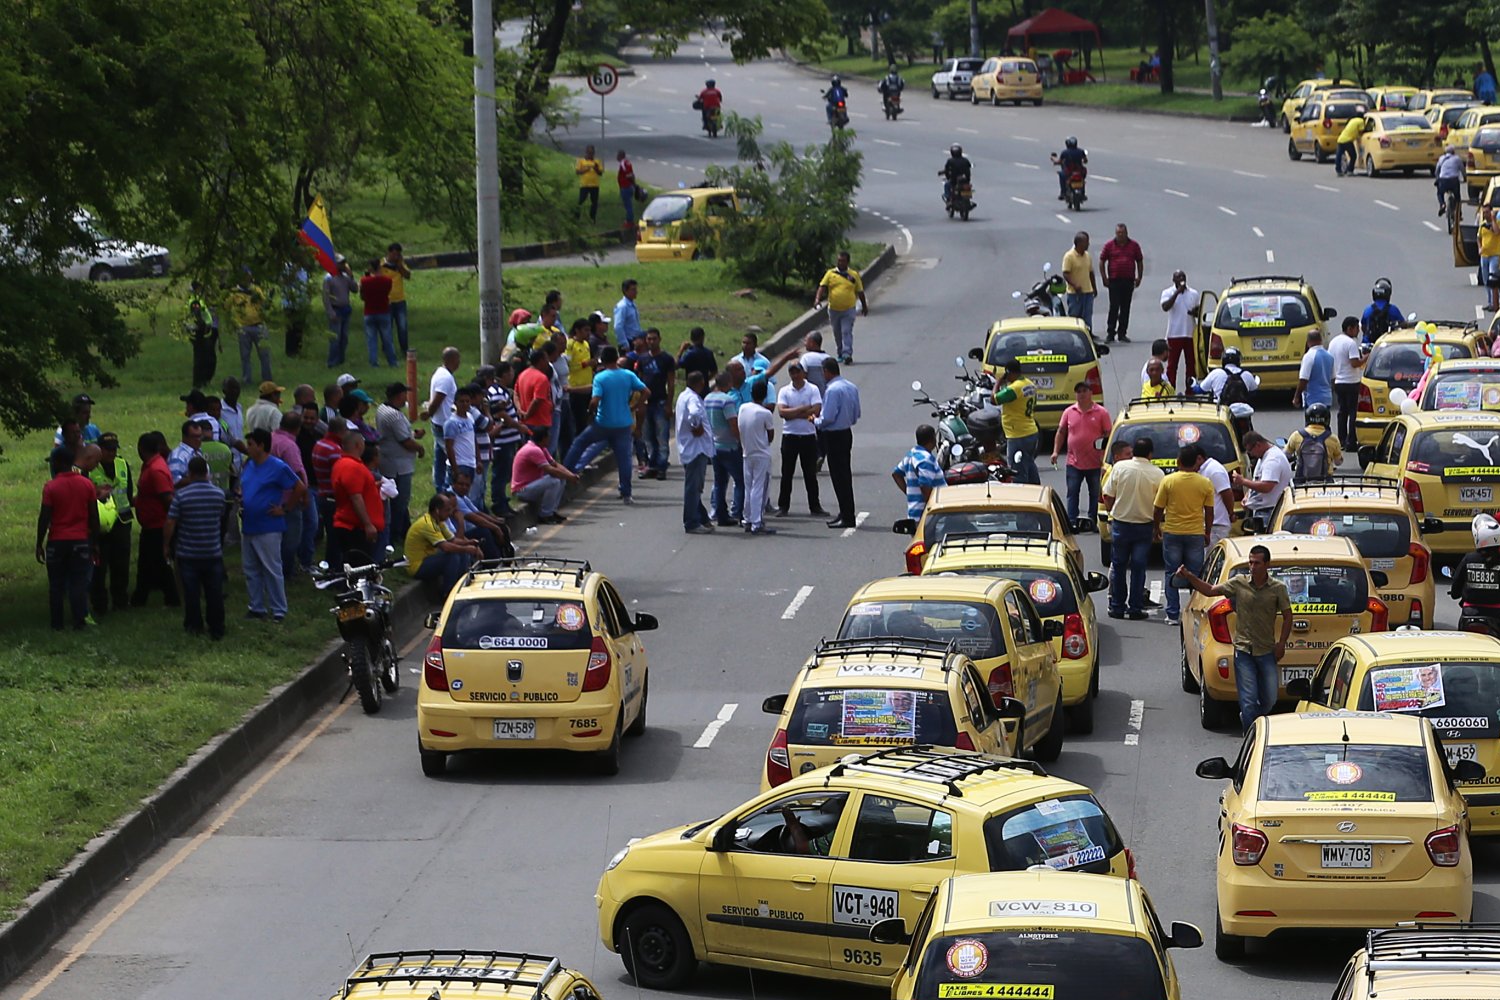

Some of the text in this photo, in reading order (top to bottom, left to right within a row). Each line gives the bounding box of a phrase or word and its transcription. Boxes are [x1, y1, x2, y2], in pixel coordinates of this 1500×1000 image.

[1294, 620, 1307, 629] KIA
[494, 638, 546, 647] 664 0000
[470, 692, 558, 701] SERVICIO PUBLICO
[569, 718, 597, 728] 7685
[1436, 719, 1487, 728] 6606060
[722, 905, 804, 921] SERVICIO PUBLICO
[843, 948, 882, 966] 9635
[986, 986, 995, 995] 4
[998, 986, 1050, 998] 444444
